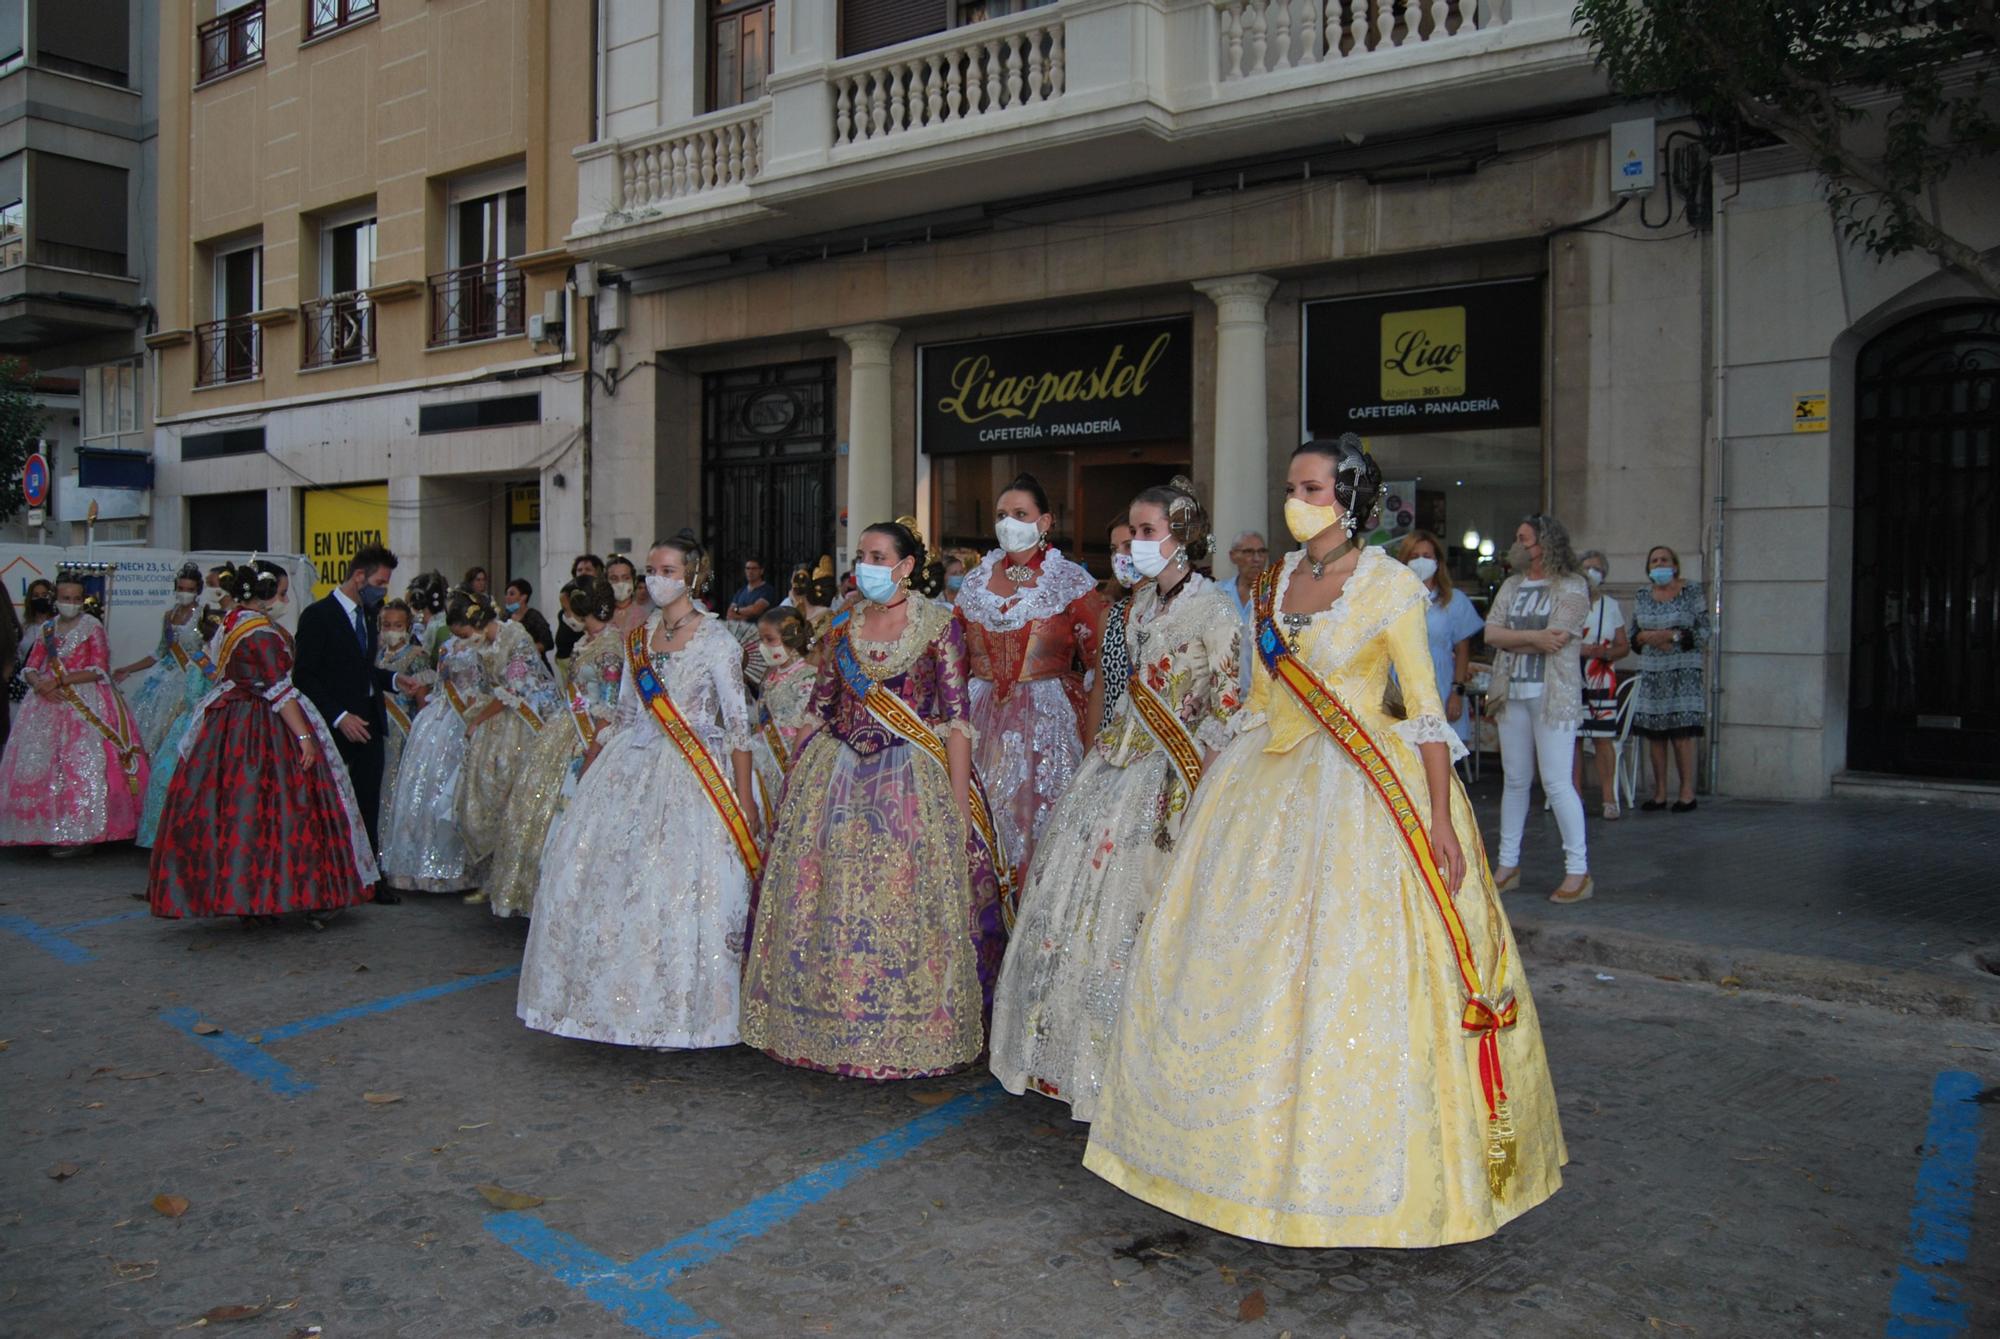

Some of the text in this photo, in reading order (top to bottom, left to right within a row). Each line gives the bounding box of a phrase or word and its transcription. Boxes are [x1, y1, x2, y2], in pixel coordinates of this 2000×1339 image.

[1384, 329, 1463, 377] Liao
[938, 332, 1171, 424] Liaopastel
[1423, 385, 1441, 396] 365
[1349, 397, 1500, 420] CAFETERÍA PANADERÍA
[979, 417, 1122, 442] CAFETERÍA PANADERÍA
[314, 529, 383, 556] EN VENTA
